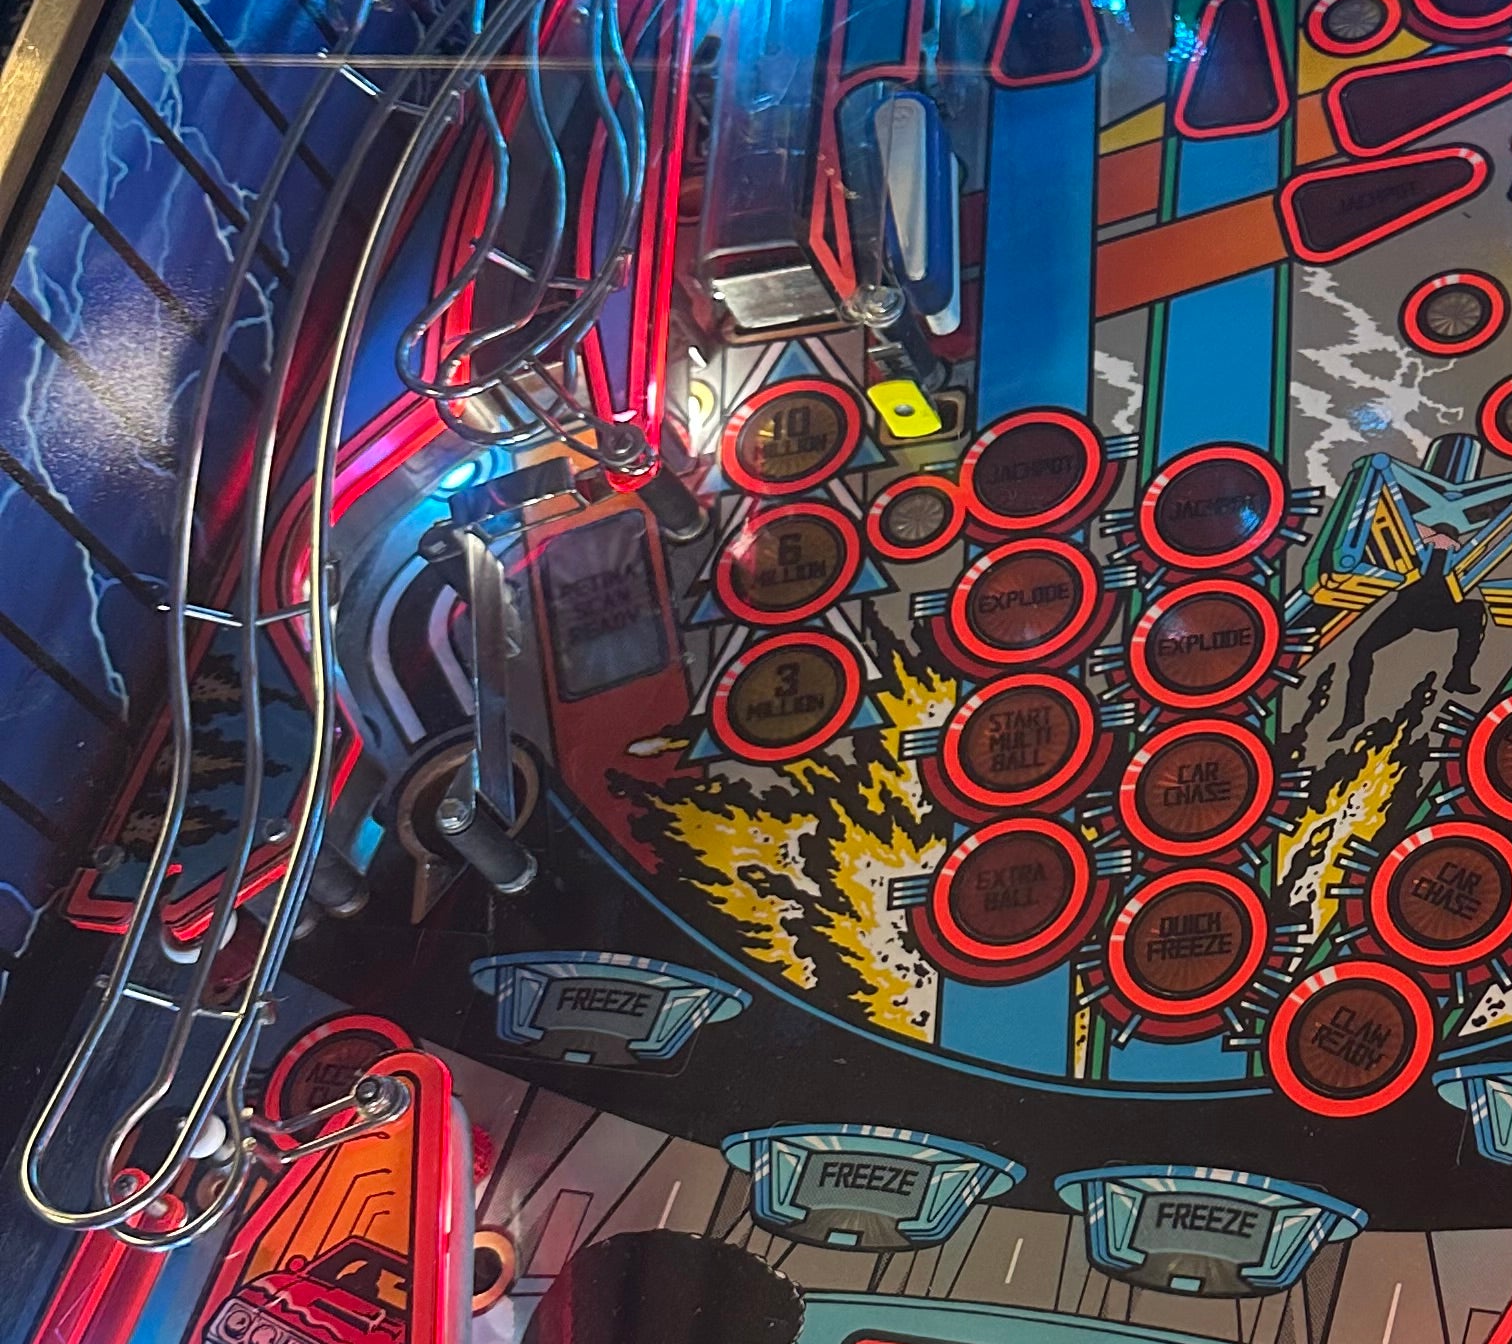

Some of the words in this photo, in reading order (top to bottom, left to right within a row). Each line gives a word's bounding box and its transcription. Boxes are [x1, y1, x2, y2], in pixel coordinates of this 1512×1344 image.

[978, 582, 1070, 613] EXPLODE
[1157, 627, 1252, 658] EXPLODE
[774, 662, 800, 697] 3
[989, 708, 1050, 732] START
[989, 727, 1052, 754] MULTI
[990, 750, 1045, 773] BALL
[1177, 761, 1220, 786] CAR
[1163, 782, 1232, 808] CHASE
[976, 862, 1046, 892] EXTRA
[1436, 861, 1483, 896] CAR
[1411, 876, 1482, 922] CHASE
[1159, 910, 1223, 937] QUICK
[1146, 932, 1233, 963] FREEZE
[556, 987, 652, 1018] FREEZE
[1331, 1005, 1392, 1050] CLAW
[1312, 1024, 1385, 1073] READY
[818, 1161, 919, 1198] FREEZE
[1155, 1200, 1261, 1239] FREEZE
